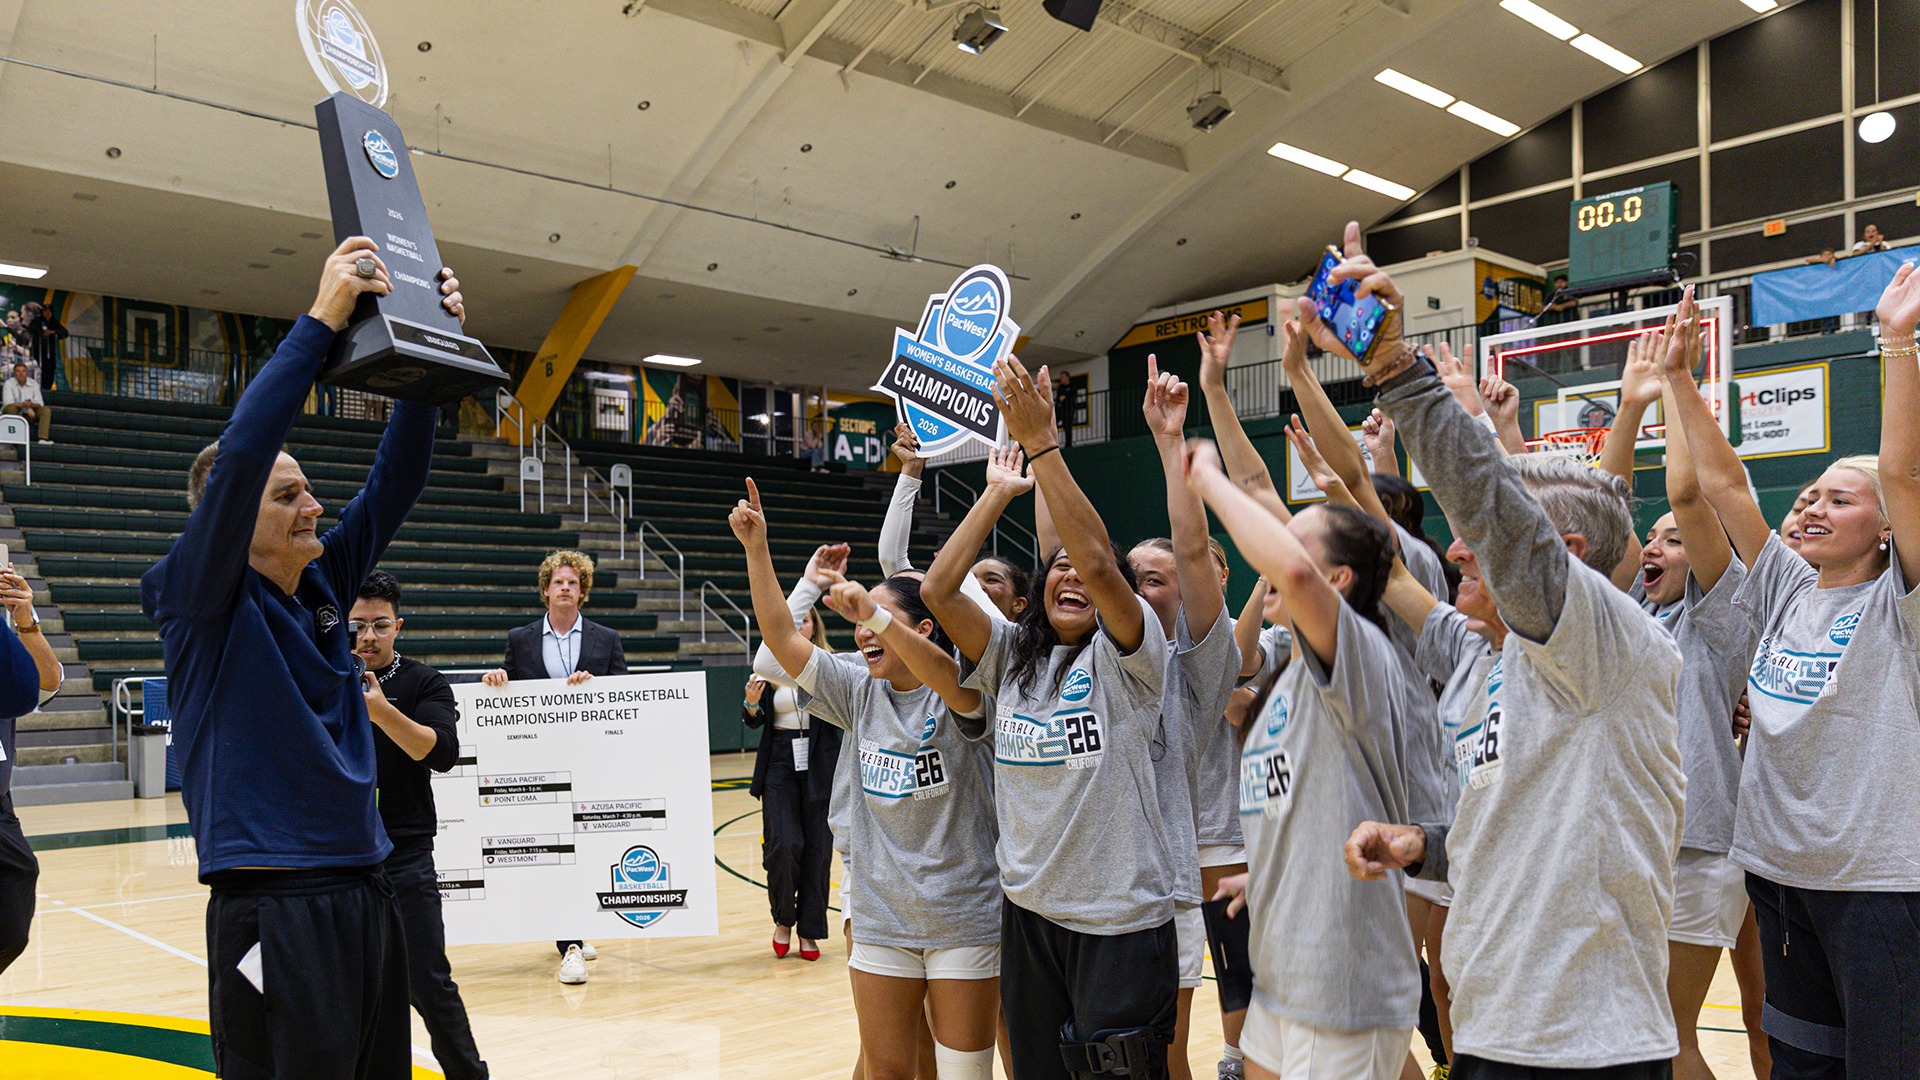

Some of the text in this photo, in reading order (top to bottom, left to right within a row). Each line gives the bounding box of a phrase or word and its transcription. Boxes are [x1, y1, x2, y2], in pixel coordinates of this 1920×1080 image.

[1578, 195, 1642, 232] 00.0
[386, 232, 418, 251] WOMEN'S
[386, 243, 425, 263] BASKETBALL
[394, 270, 431, 290] CHAMPIONS
[946, 313, 988, 339] PacWest
[423, 334, 460, 351] VANGUARD
[545, 361, 554, 377] B
[907, 343, 998, 391] WOMEN'S BASKETBAL
[893, 363, 994, 427] CHAMPIONS
[8, 425, 16, 434] B
[839, 417, 877, 435] SECTIONS
[917, 417, 939, 436] 2026
[834, 433, 881, 464] A-D
[1830, 629, 1855, 637] PacW
[475, 695, 536, 710] PACWEST
[608, 688, 690, 704] BASKETBALL
[476, 711, 578, 728] CHAMPIONSHIP
[581, 708, 640, 722] BRACKET
[506, 733, 538, 741] SEMIFINALS
[1065, 714, 1102, 755] 26
[996, 732, 1037, 759] HAMPS
[914, 751, 945, 788] 26
[913, 784, 950, 802] CALIFORNIA
[591, 803, 614, 811] AZUSA
[592, 821, 631, 830] VANGUARD
[497, 837, 536, 845] VANGUARD
[497, 855, 538, 863] WESTMONT
[618, 882, 664, 891] BASKETBALL
[602, 893, 683, 905] CHAMPIONSHIPS
